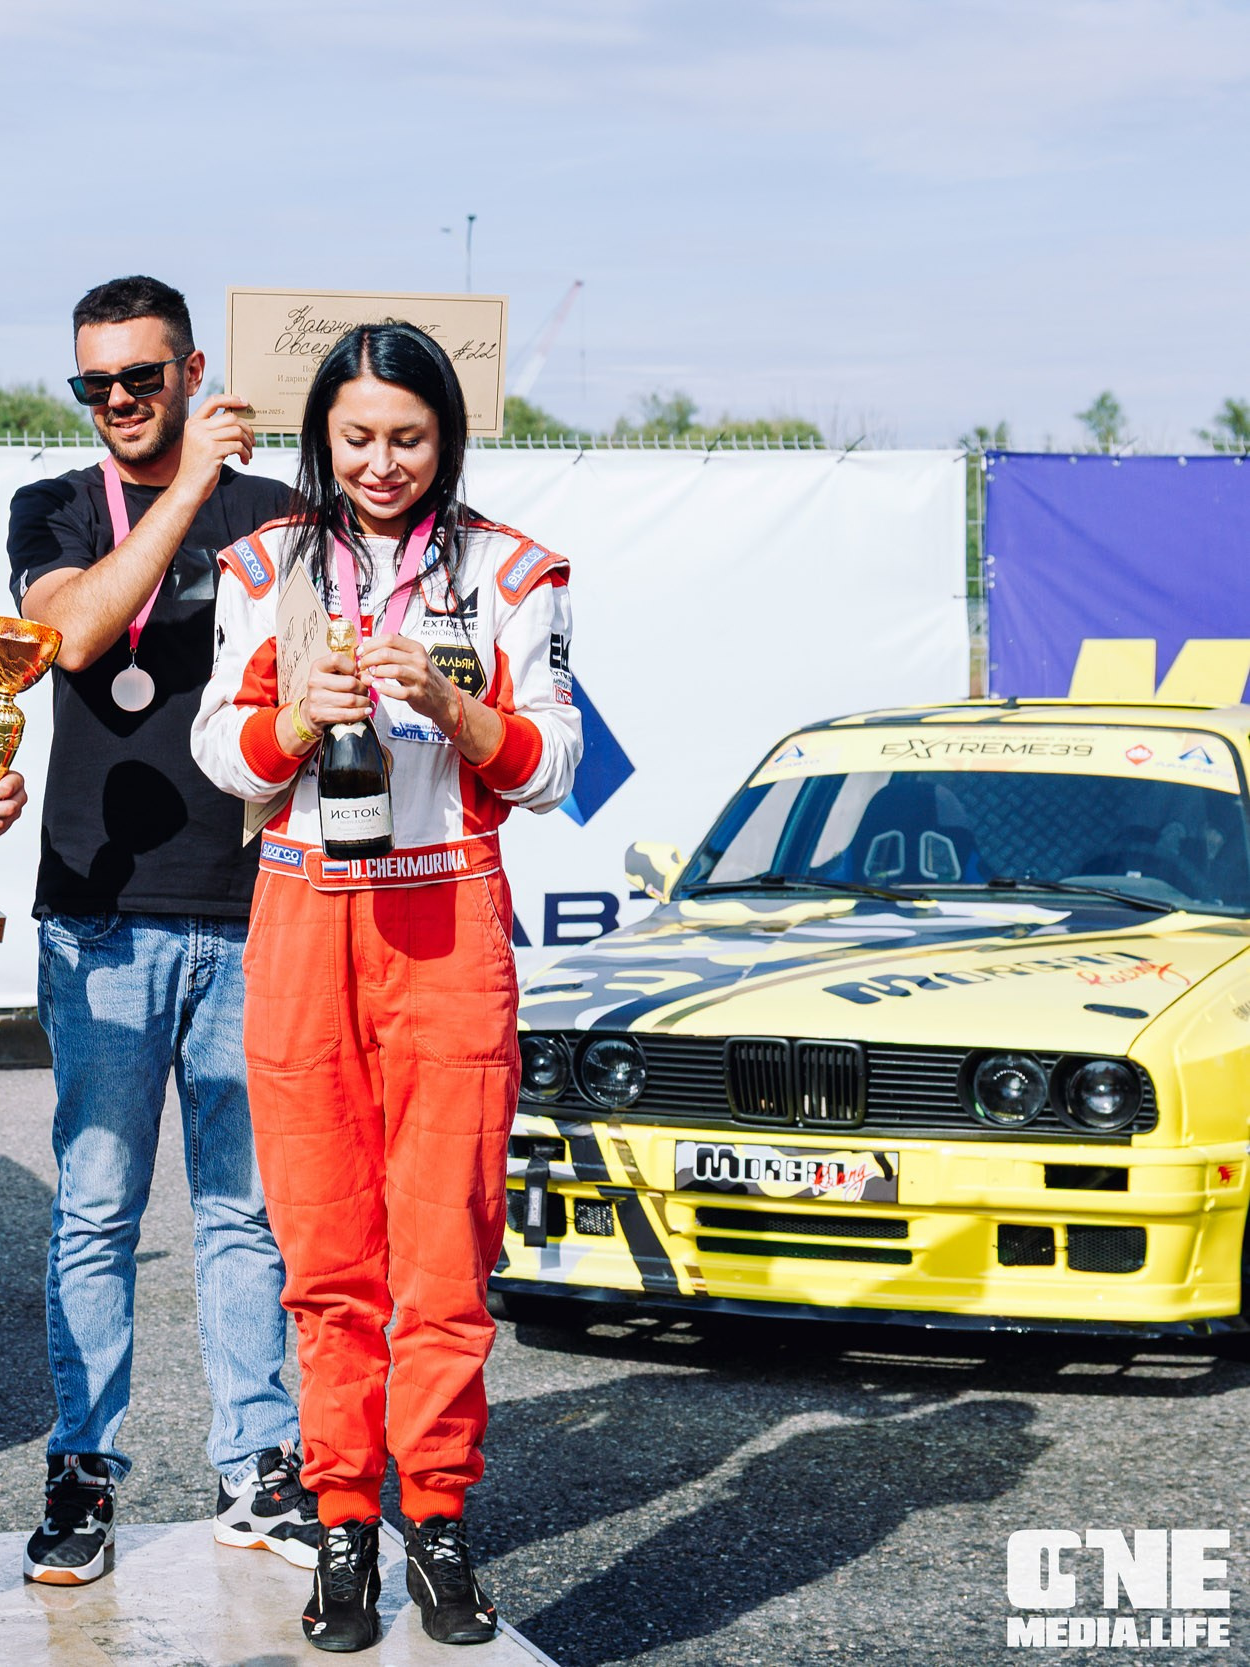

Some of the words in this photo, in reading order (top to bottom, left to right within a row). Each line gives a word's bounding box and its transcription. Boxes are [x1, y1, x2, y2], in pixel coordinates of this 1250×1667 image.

[235, 539, 266, 582] sparco
[506, 548, 546, 588] sparco
[422, 618, 479, 632] EXTREME
[431, 655, 475, 671] КАЛЬЯН
[881, 737, 1094, 760] EXTREME39
[330, 806, 381, 820] ИСТОК
[262, 843, 300, 865] sparco
